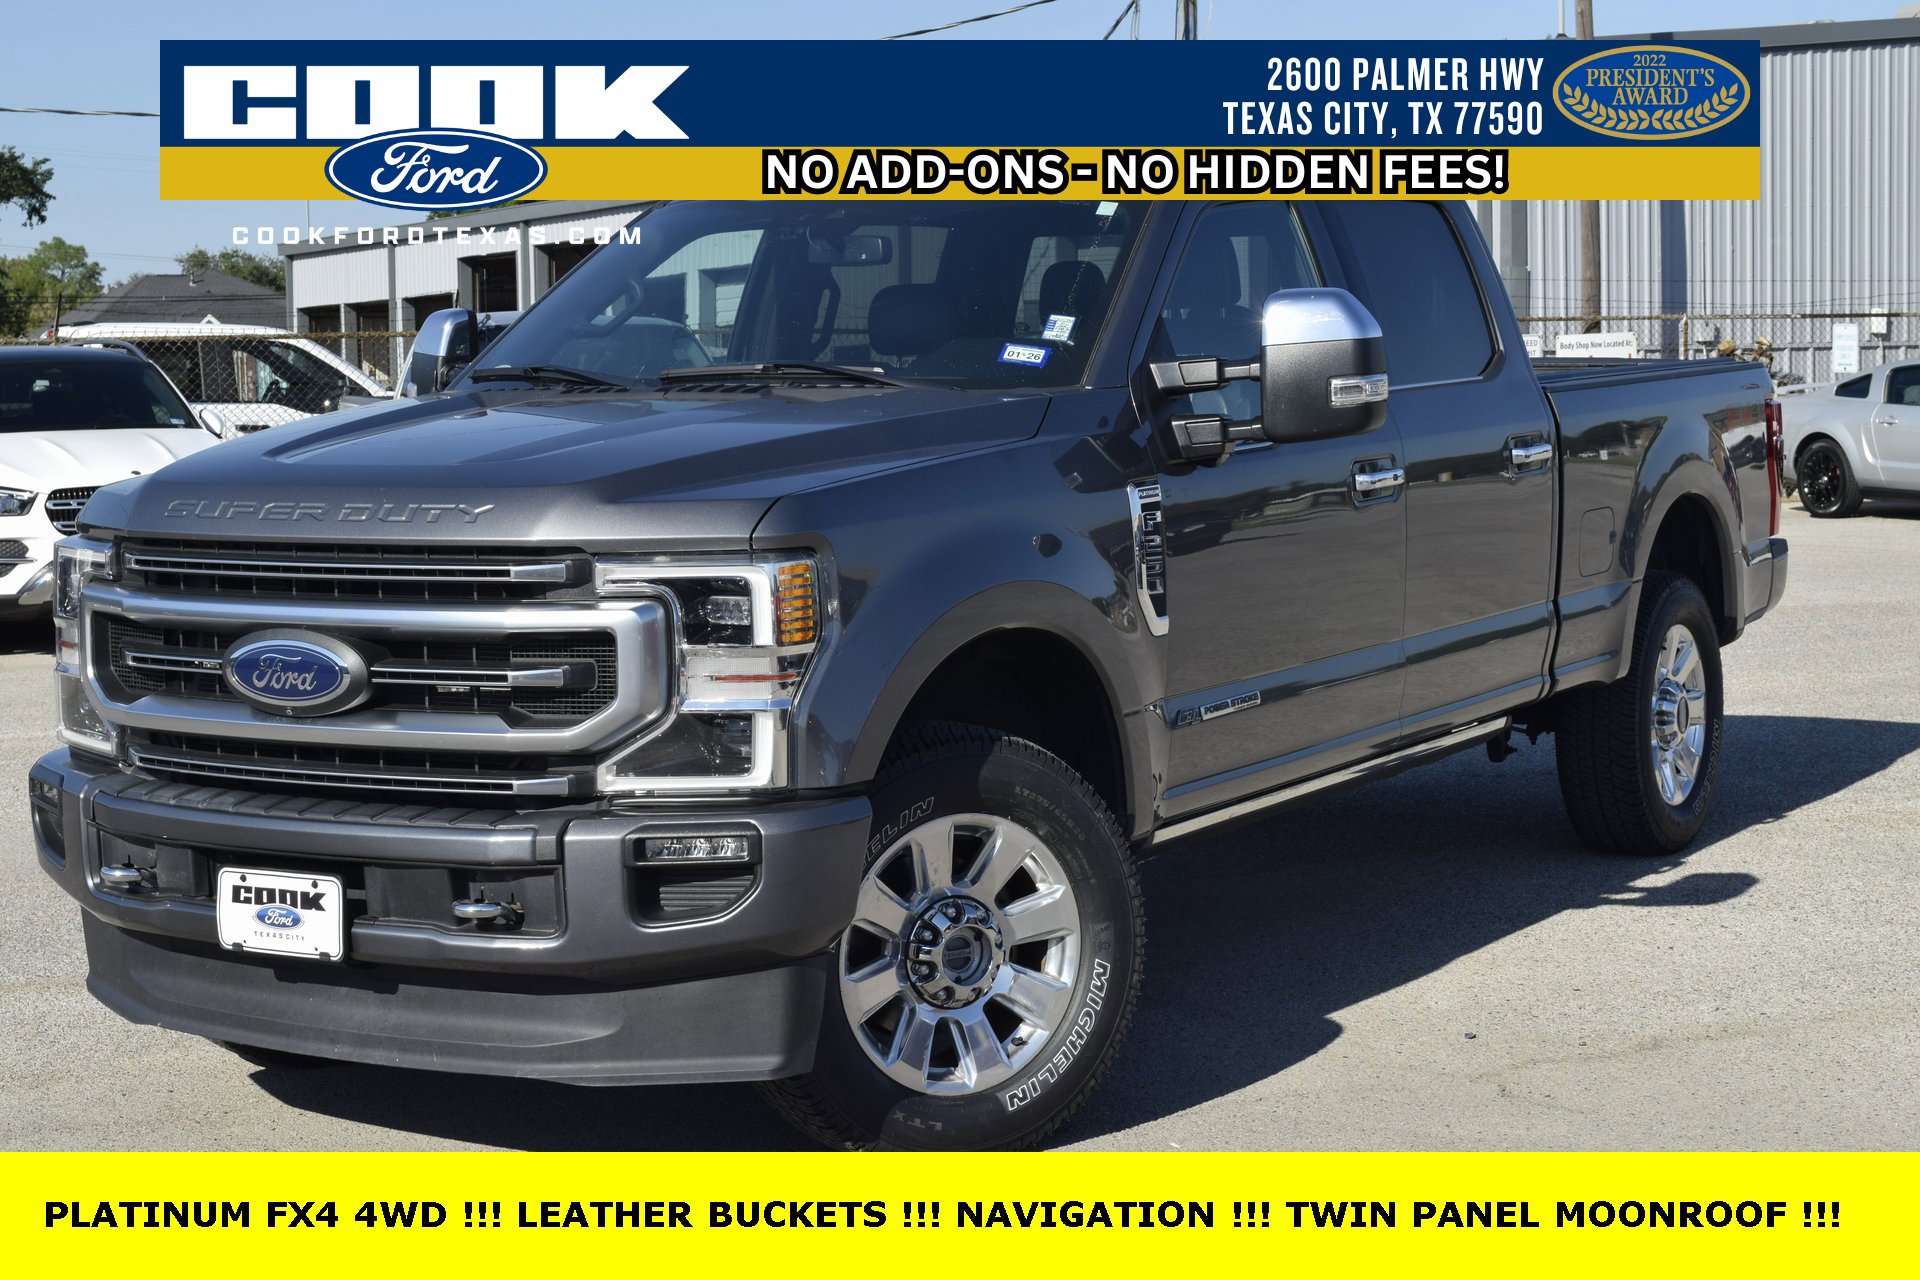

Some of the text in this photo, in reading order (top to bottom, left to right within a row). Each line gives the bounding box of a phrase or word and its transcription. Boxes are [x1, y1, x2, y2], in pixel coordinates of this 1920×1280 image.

[1560, 342, 1574, 351] Body
[1575, 341, 1589, 349] Shop
[1603, 340, 1625, 348] Located
[164, 499, 496, 524] SUPER DUTY
[252, 653, 318, 692] Ford
[863, 797, 934, 868] ELIN
[231, 884, 327, 912] COOK
[264, 908, 294, 927] Ford
[1006, 959, 1111, 1111] MICHELIN
